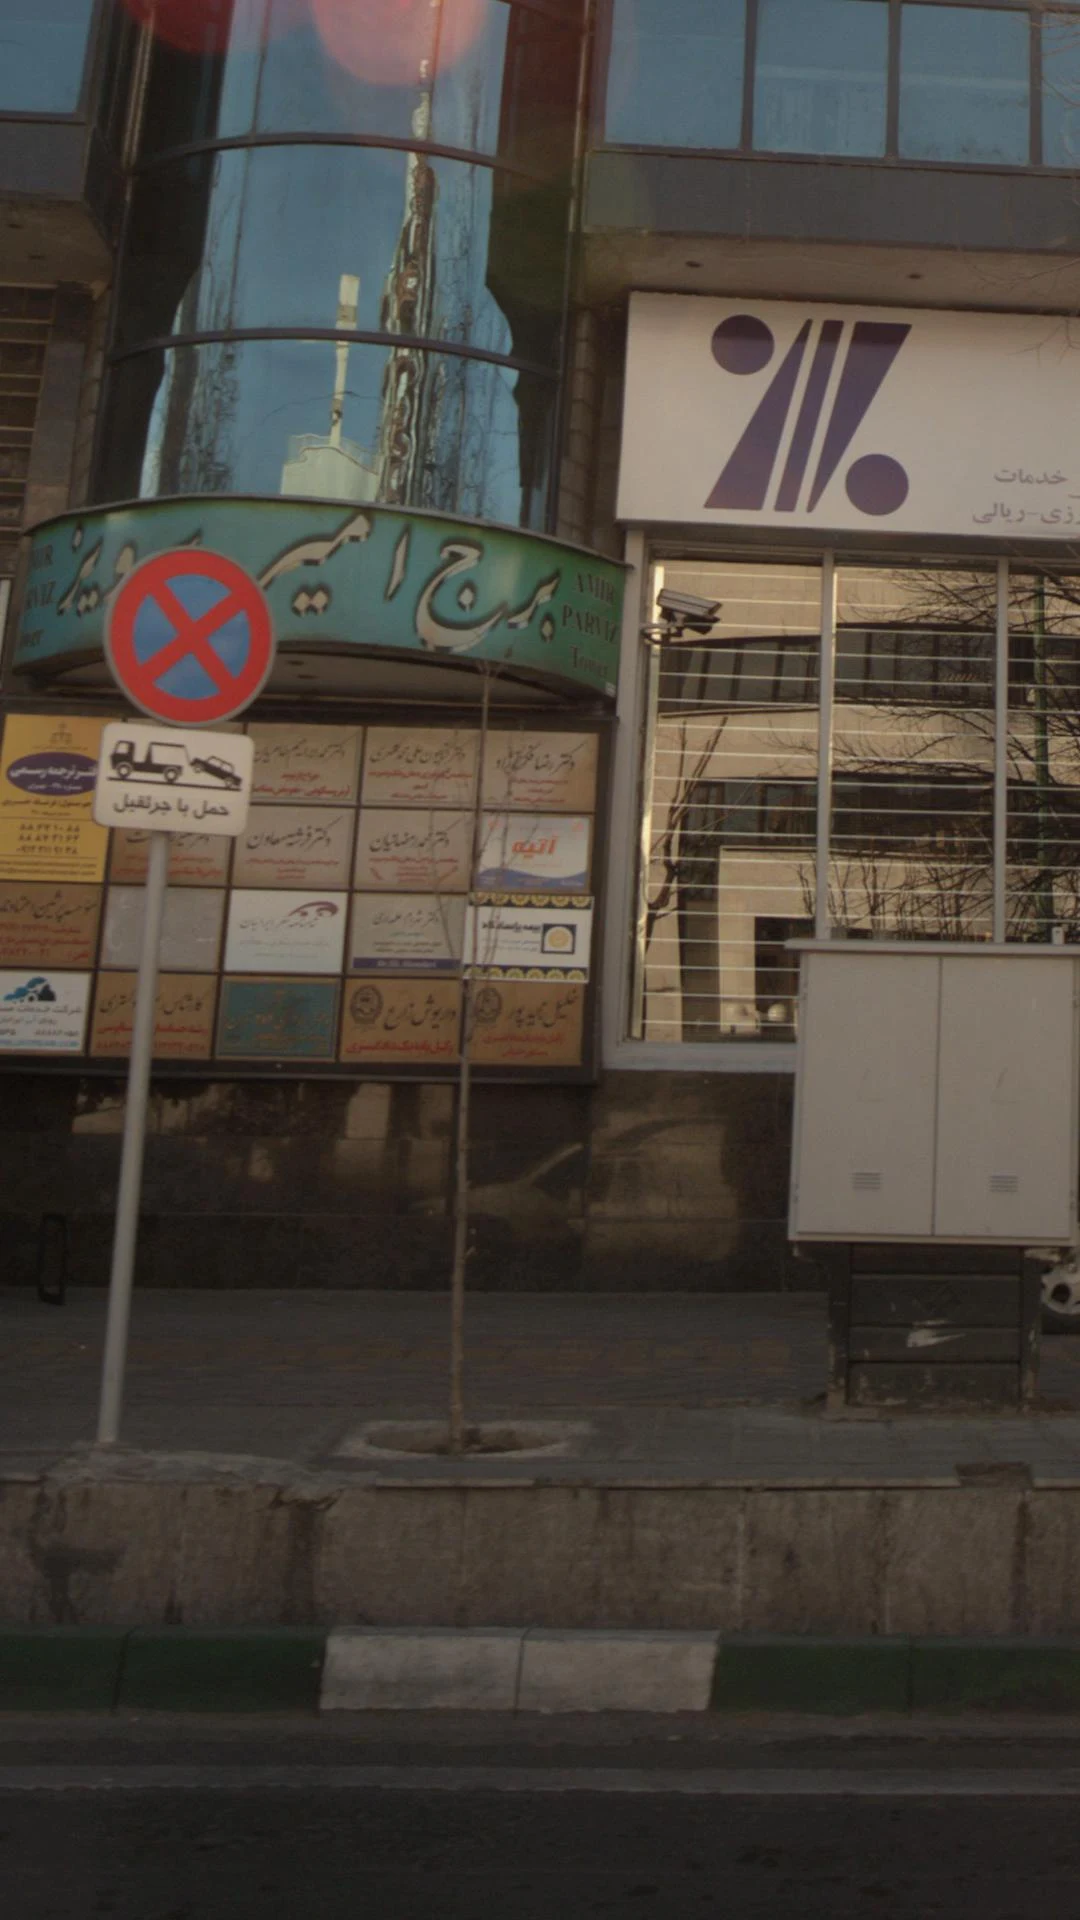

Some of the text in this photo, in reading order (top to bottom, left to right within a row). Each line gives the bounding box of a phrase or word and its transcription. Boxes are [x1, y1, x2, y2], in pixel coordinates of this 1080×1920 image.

[993, 467, 1069, 485] خدمات
[414, 538, 561, 651] برج
[112, 793, 173, 815] جرثقیل
[176, 797, 189, 817] با
[193, 799, 230, 819] حمل
